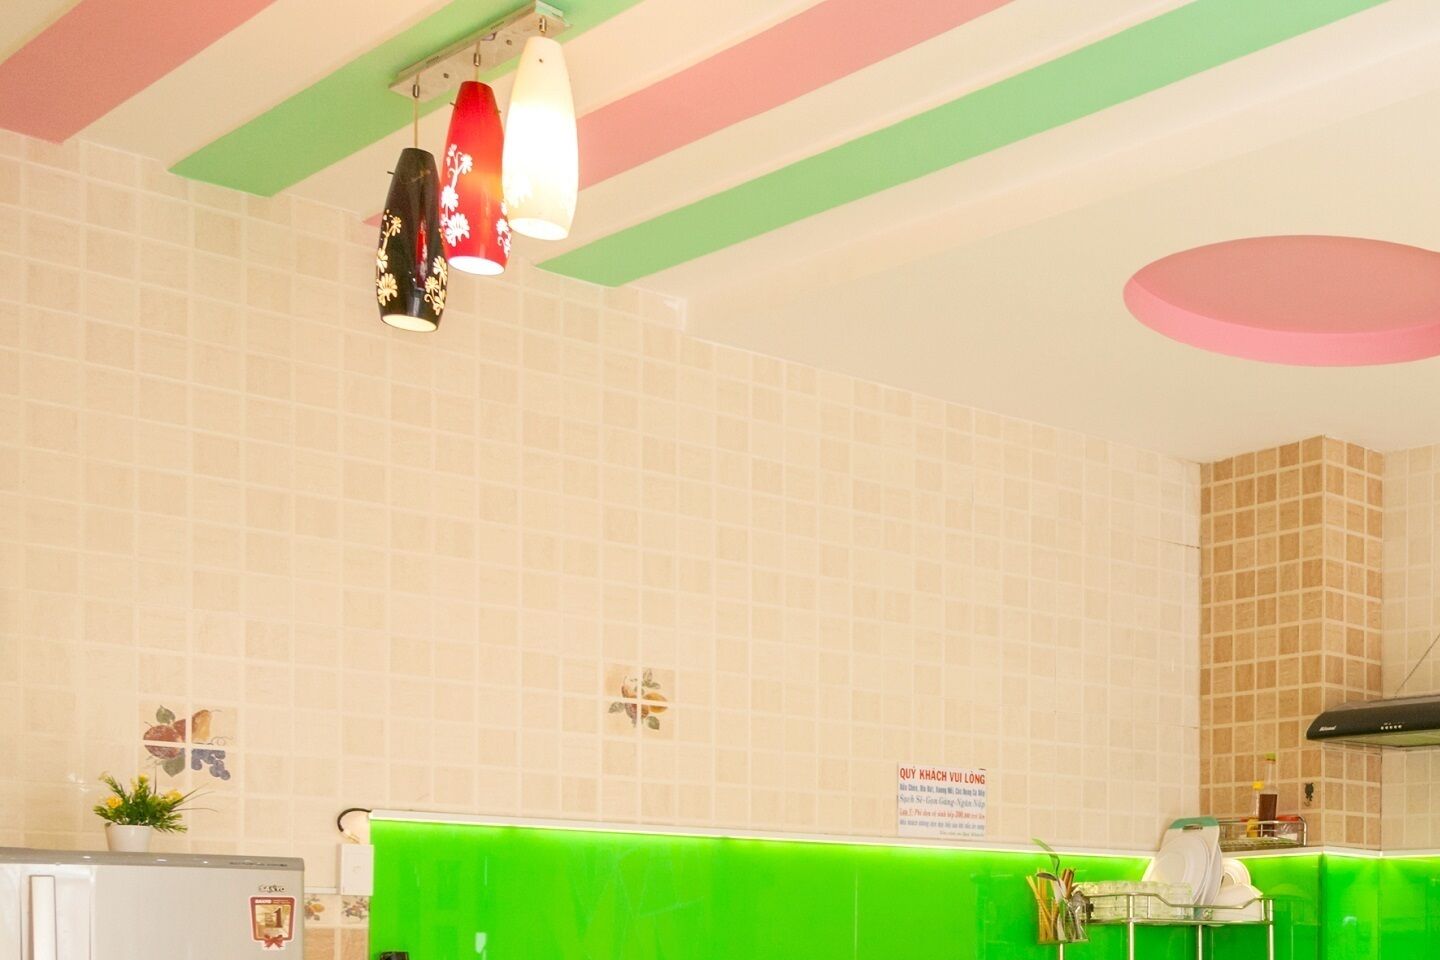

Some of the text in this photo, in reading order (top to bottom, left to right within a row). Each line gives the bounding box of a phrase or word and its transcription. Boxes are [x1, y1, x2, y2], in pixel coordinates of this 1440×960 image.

[919, 767, 947, 782] KHÁCH
[950, 771, 963, 783] VUI
[964, 770, 986, 785] LÒNG
[273, 907, 283, 928] 1
